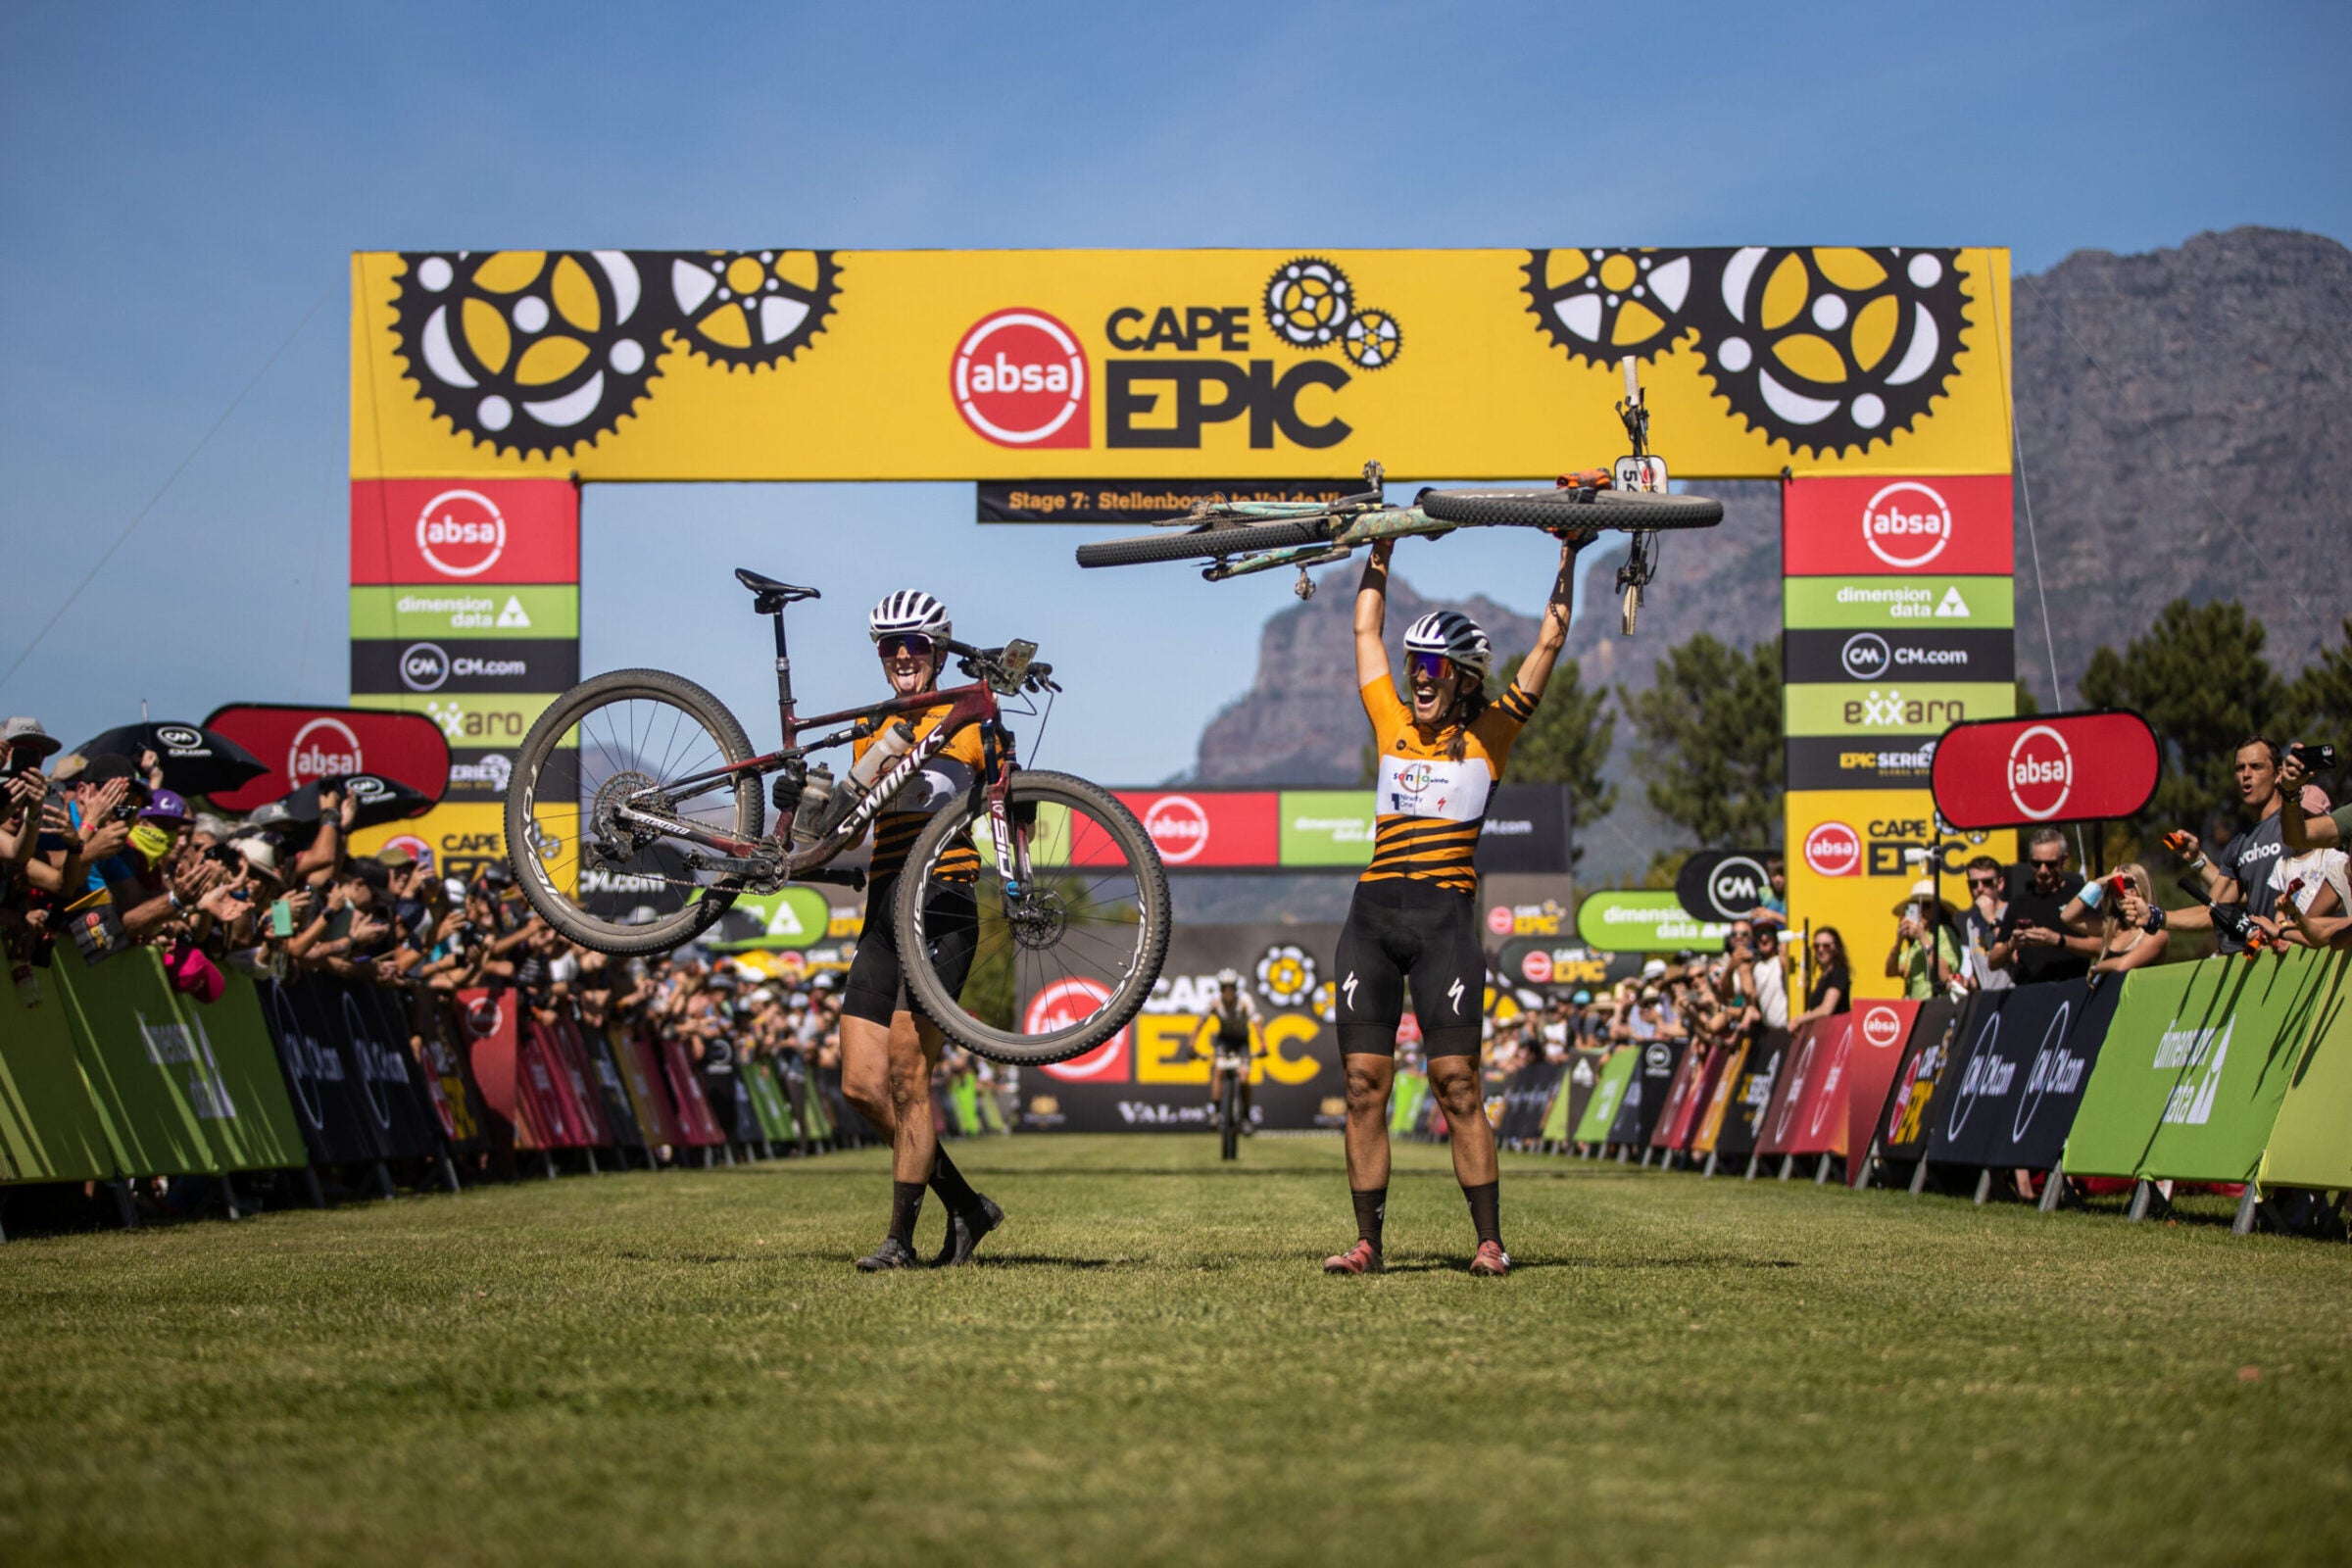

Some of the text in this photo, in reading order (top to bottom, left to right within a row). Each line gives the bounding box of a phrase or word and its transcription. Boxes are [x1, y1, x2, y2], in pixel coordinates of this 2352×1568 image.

[1105, 307, 1250, 352] CAPE
[971, 352, 1069, 392] absa
[1105, 359, 1354, 450] EPIC
[1008, 492, 1066, 514] Stage
[1071, 492, 1090, 510] 7:
[428, 514, 495, 543] absa
[1874, 506, 1941, 535] absa
[397, 596, 493, 612] dimension
[1837, 586, 1932, 603] dimension
[1890, 601, 1932, 618] data
[451, 612, 493, 628] data
[1894, 648, 1968, 665] CM.com
[452, 658, 526, 676] CM.com
[1844, 690, 1965, 725] exxaro
[298, 744, 354, 775] absa
[2015, 753, 2065, 785] absa
[837, 724, 946, 835] S-WORKS
[1868, 820, 1927, 838] CAPE
[443, 834, 500, 852] CAPE
[1812, 838, 1853, 857] absa
[1603, 905, 1692, 924] dimensio
[1656, 920, 1698, 939] data
[1868, 1017, 1896, 1033] absa
